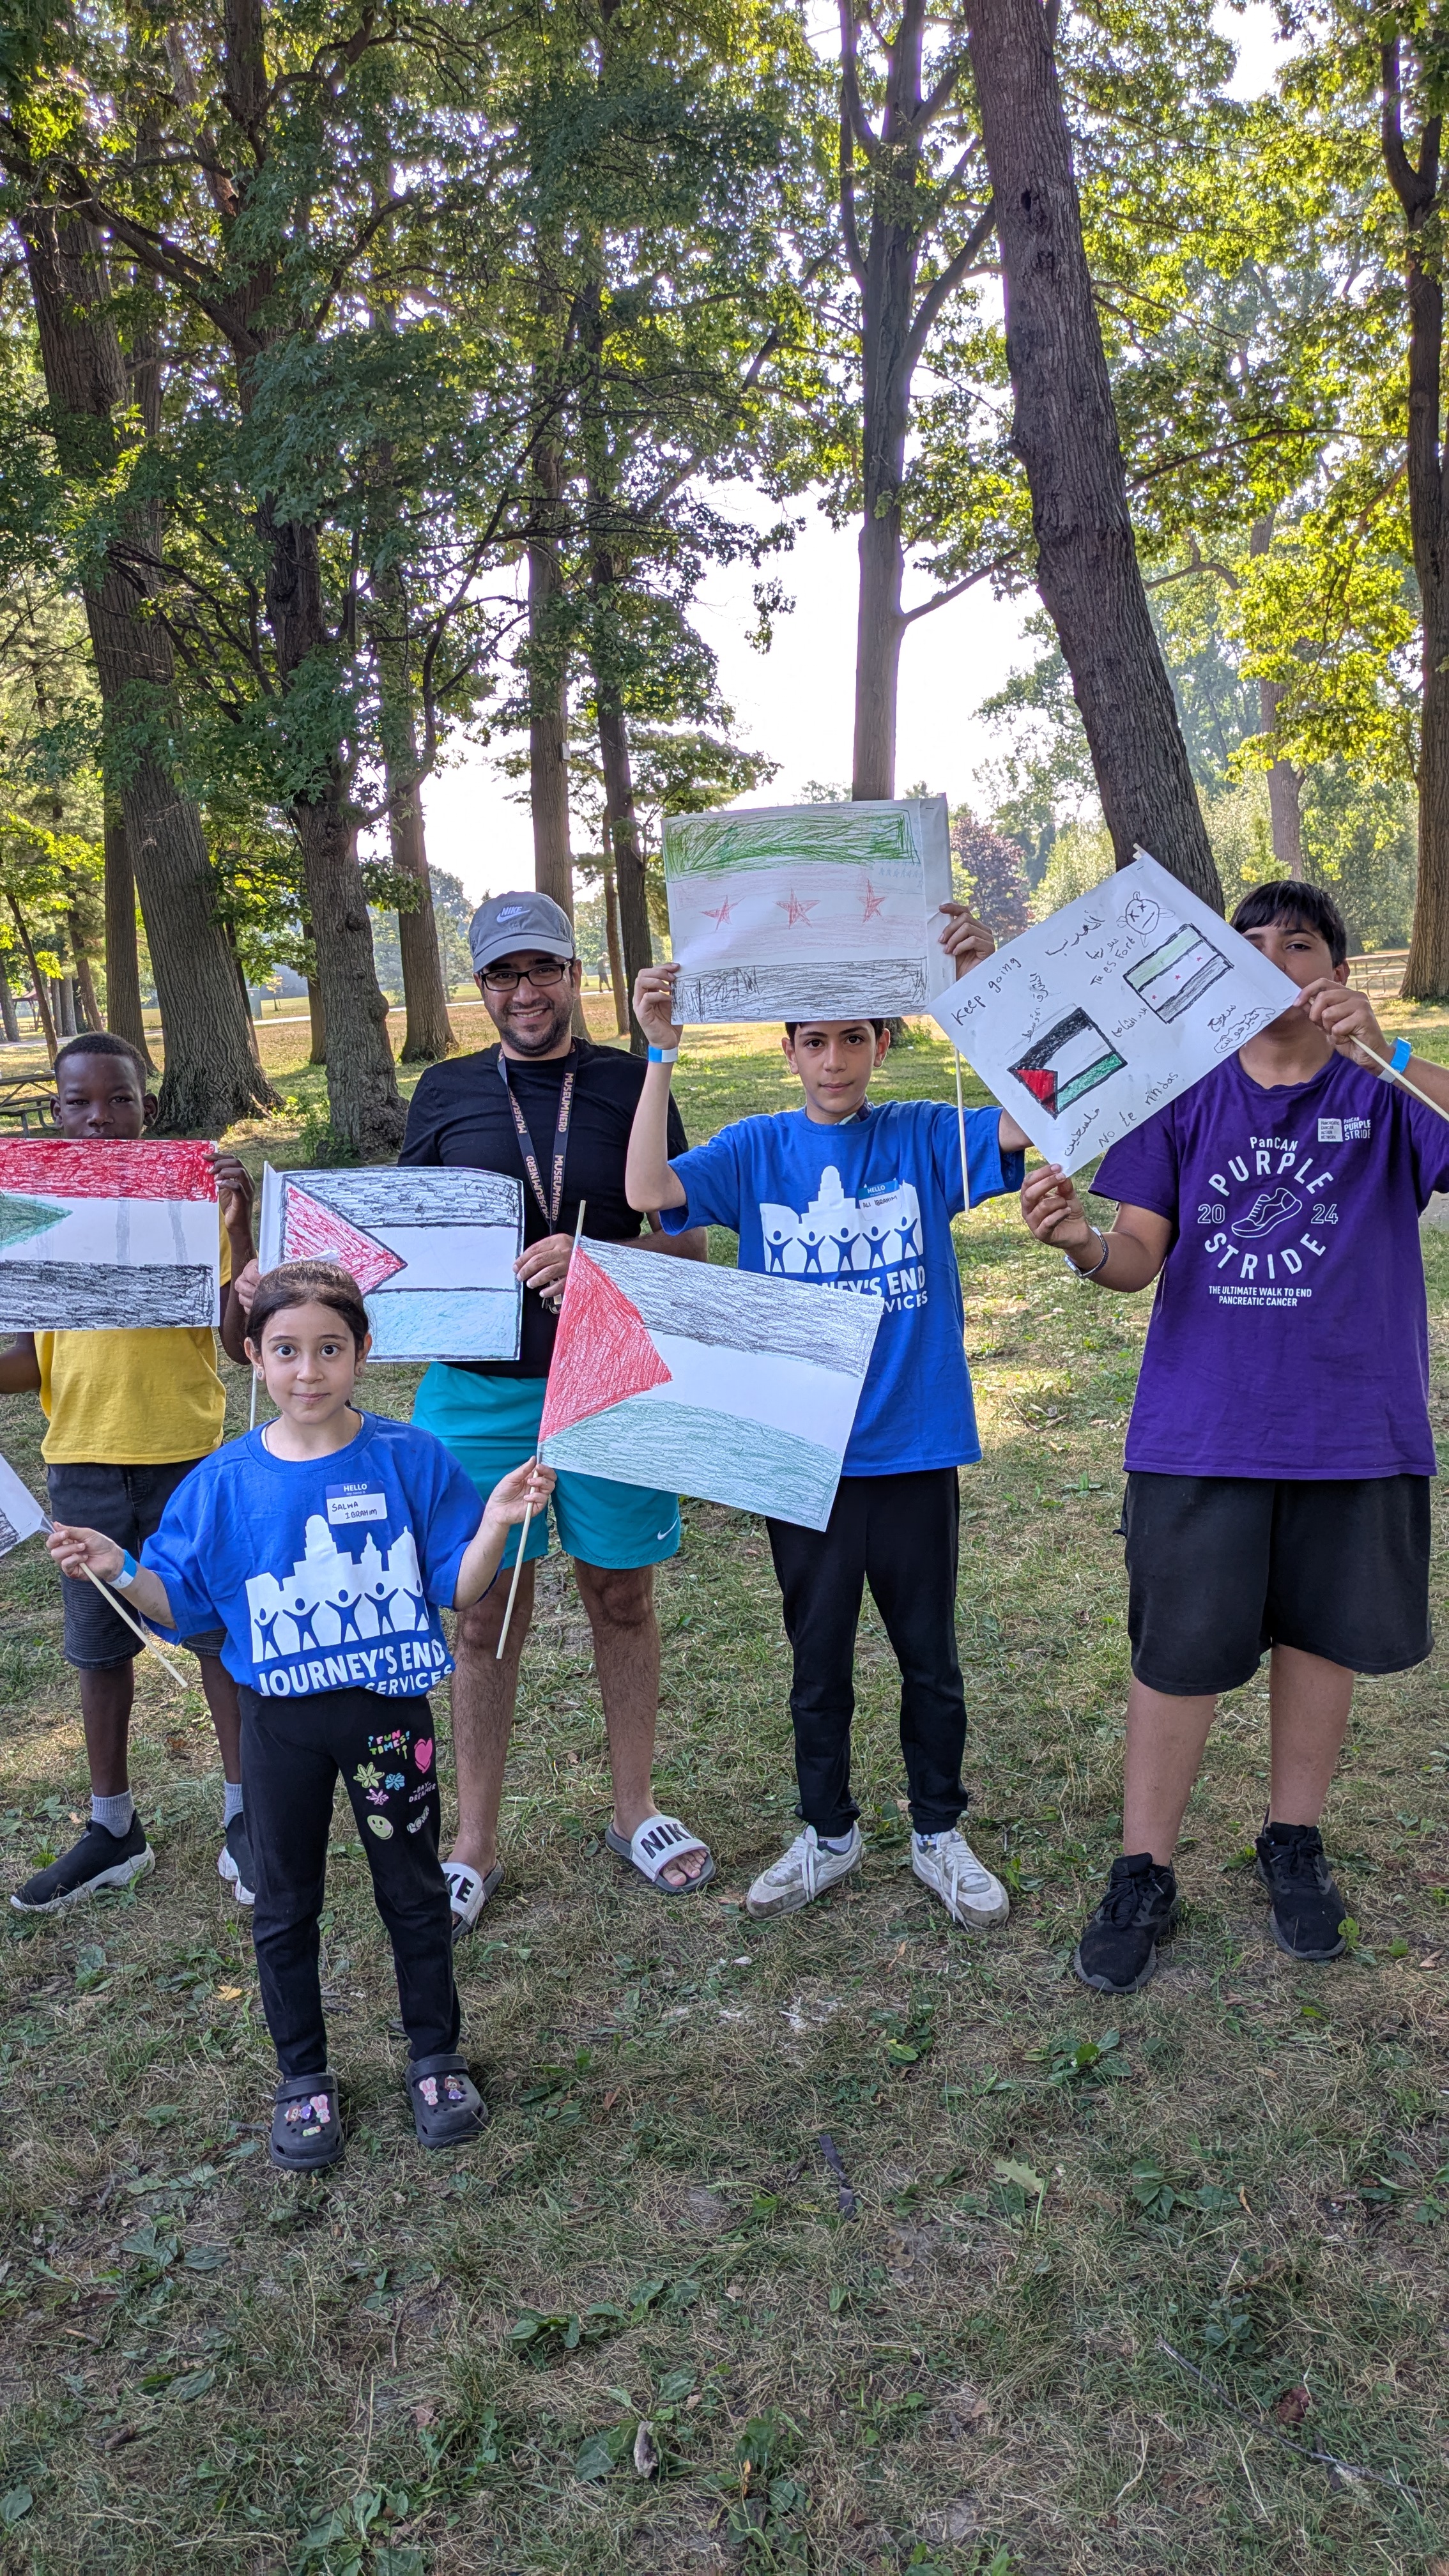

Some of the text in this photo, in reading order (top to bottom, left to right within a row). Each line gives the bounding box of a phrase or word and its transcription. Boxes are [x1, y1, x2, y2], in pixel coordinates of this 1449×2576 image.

[501, 906, 523, 916] NIKE
[1090, 975, 1103, 985] Tu
[1114, 936, 1135, 959] Fort
[988, 958, 1022, 993] going
[1098, 1131, 1116, 1148] No
[1119, 1111, 1137, 1128] te
[1344, 1119, 1371, 1132] PURPLE
[1250, 1137, 1298, 1151] PanCAN
[1208, 1151, 1334, 1197] PURPLE
[867, 1184, 885, 1194] HELLO
[1204, 1232, 1326, 1280] STRIDE
[886, 1265, 926, 1296] END
[1209, 1285, 1312, 1298] THE ULTIMATE WALK TO END
[1218, 1295, 1298, 1307] PANCREATIC CANCER
[343, 1483, 367, 1492] HELLO
[332, 1501, 358, 1512] SALWA
[400, 1638, 445, 1671] END
[376, 1729, 401, 1745] FUN
[409, 1783, 436, 1802] DREAMER
[640, 1823, 695, 1859] NIK
